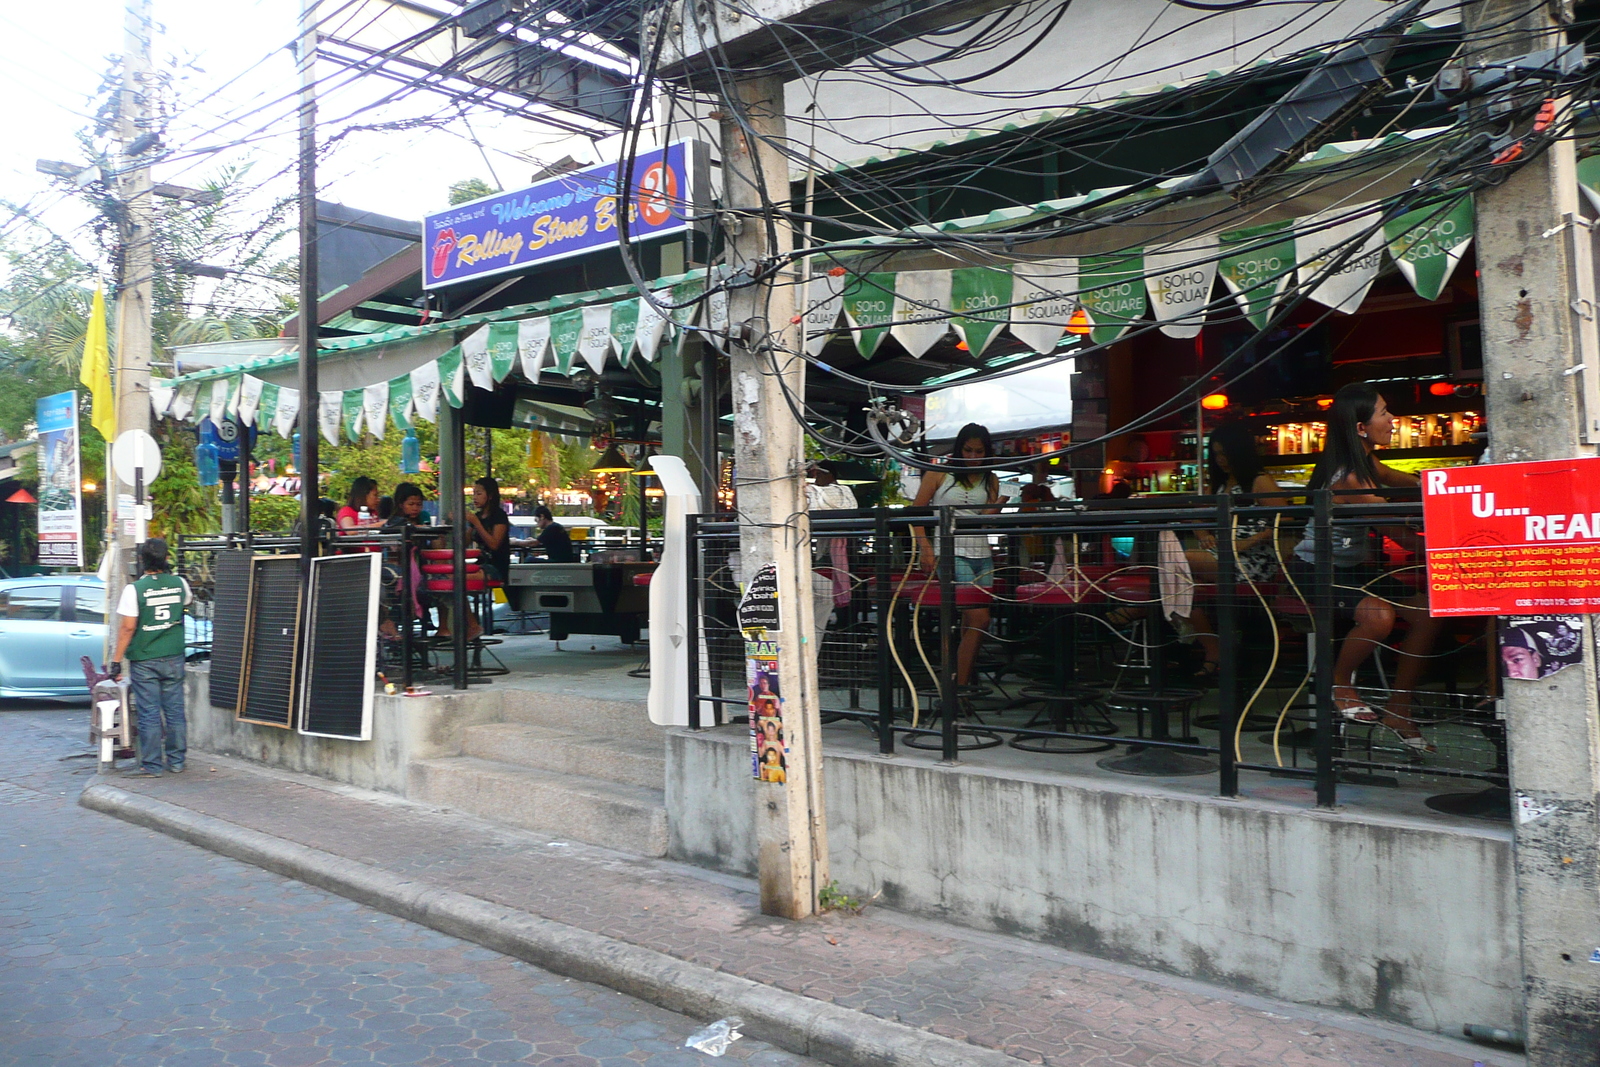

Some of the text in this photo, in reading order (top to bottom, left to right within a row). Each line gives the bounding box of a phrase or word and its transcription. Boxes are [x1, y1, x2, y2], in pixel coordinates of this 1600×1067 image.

[644, 167, 669, 217] 2
[491, 189, 574, 224] Welcome
[456, 229, 524, 268] Rolling
[529, 213, 588, 250] Stone
[1237, 257, 1281, 275] SOHO
[1164, 271, 1205, 288] SOHO
[1093, 282, 1132, 299] SOHO
[808, 299, 832, 311] OHO
[856, 300, 887, 312] SOHO
[965, 295, 999, 309] SOHO
[1095, 297, 1144, 314] SQUARE
[1029, 303, 1074, 320] SQUARE
[1430, 552, 1460, 560] Lease
[1461, 550, 1503, 558] building
[1521, 547, 1563, 556] Walking
[1431, 562, 1453, 570] Very
[1455, 560, 1514, 569] reasonable
[1515, 558, 1550, 567] prices.
[1569, 556, 1590, 566] key
[1431, 573, 1451, 581] Pay
[1461, 571, 1495, 579] month
[1496, 569, 1553, 578] advanced
[1554, 567, 1586, 576] rental
[1432, 583, 1461, 591] Open
[1463, 583, 1486, 591] your
[1487, 580, 1530, 589] business
[1548, 579, 1566, 587] this
[1567, 578, 1592, 588] high
[155, 604, 171, 621] 5
